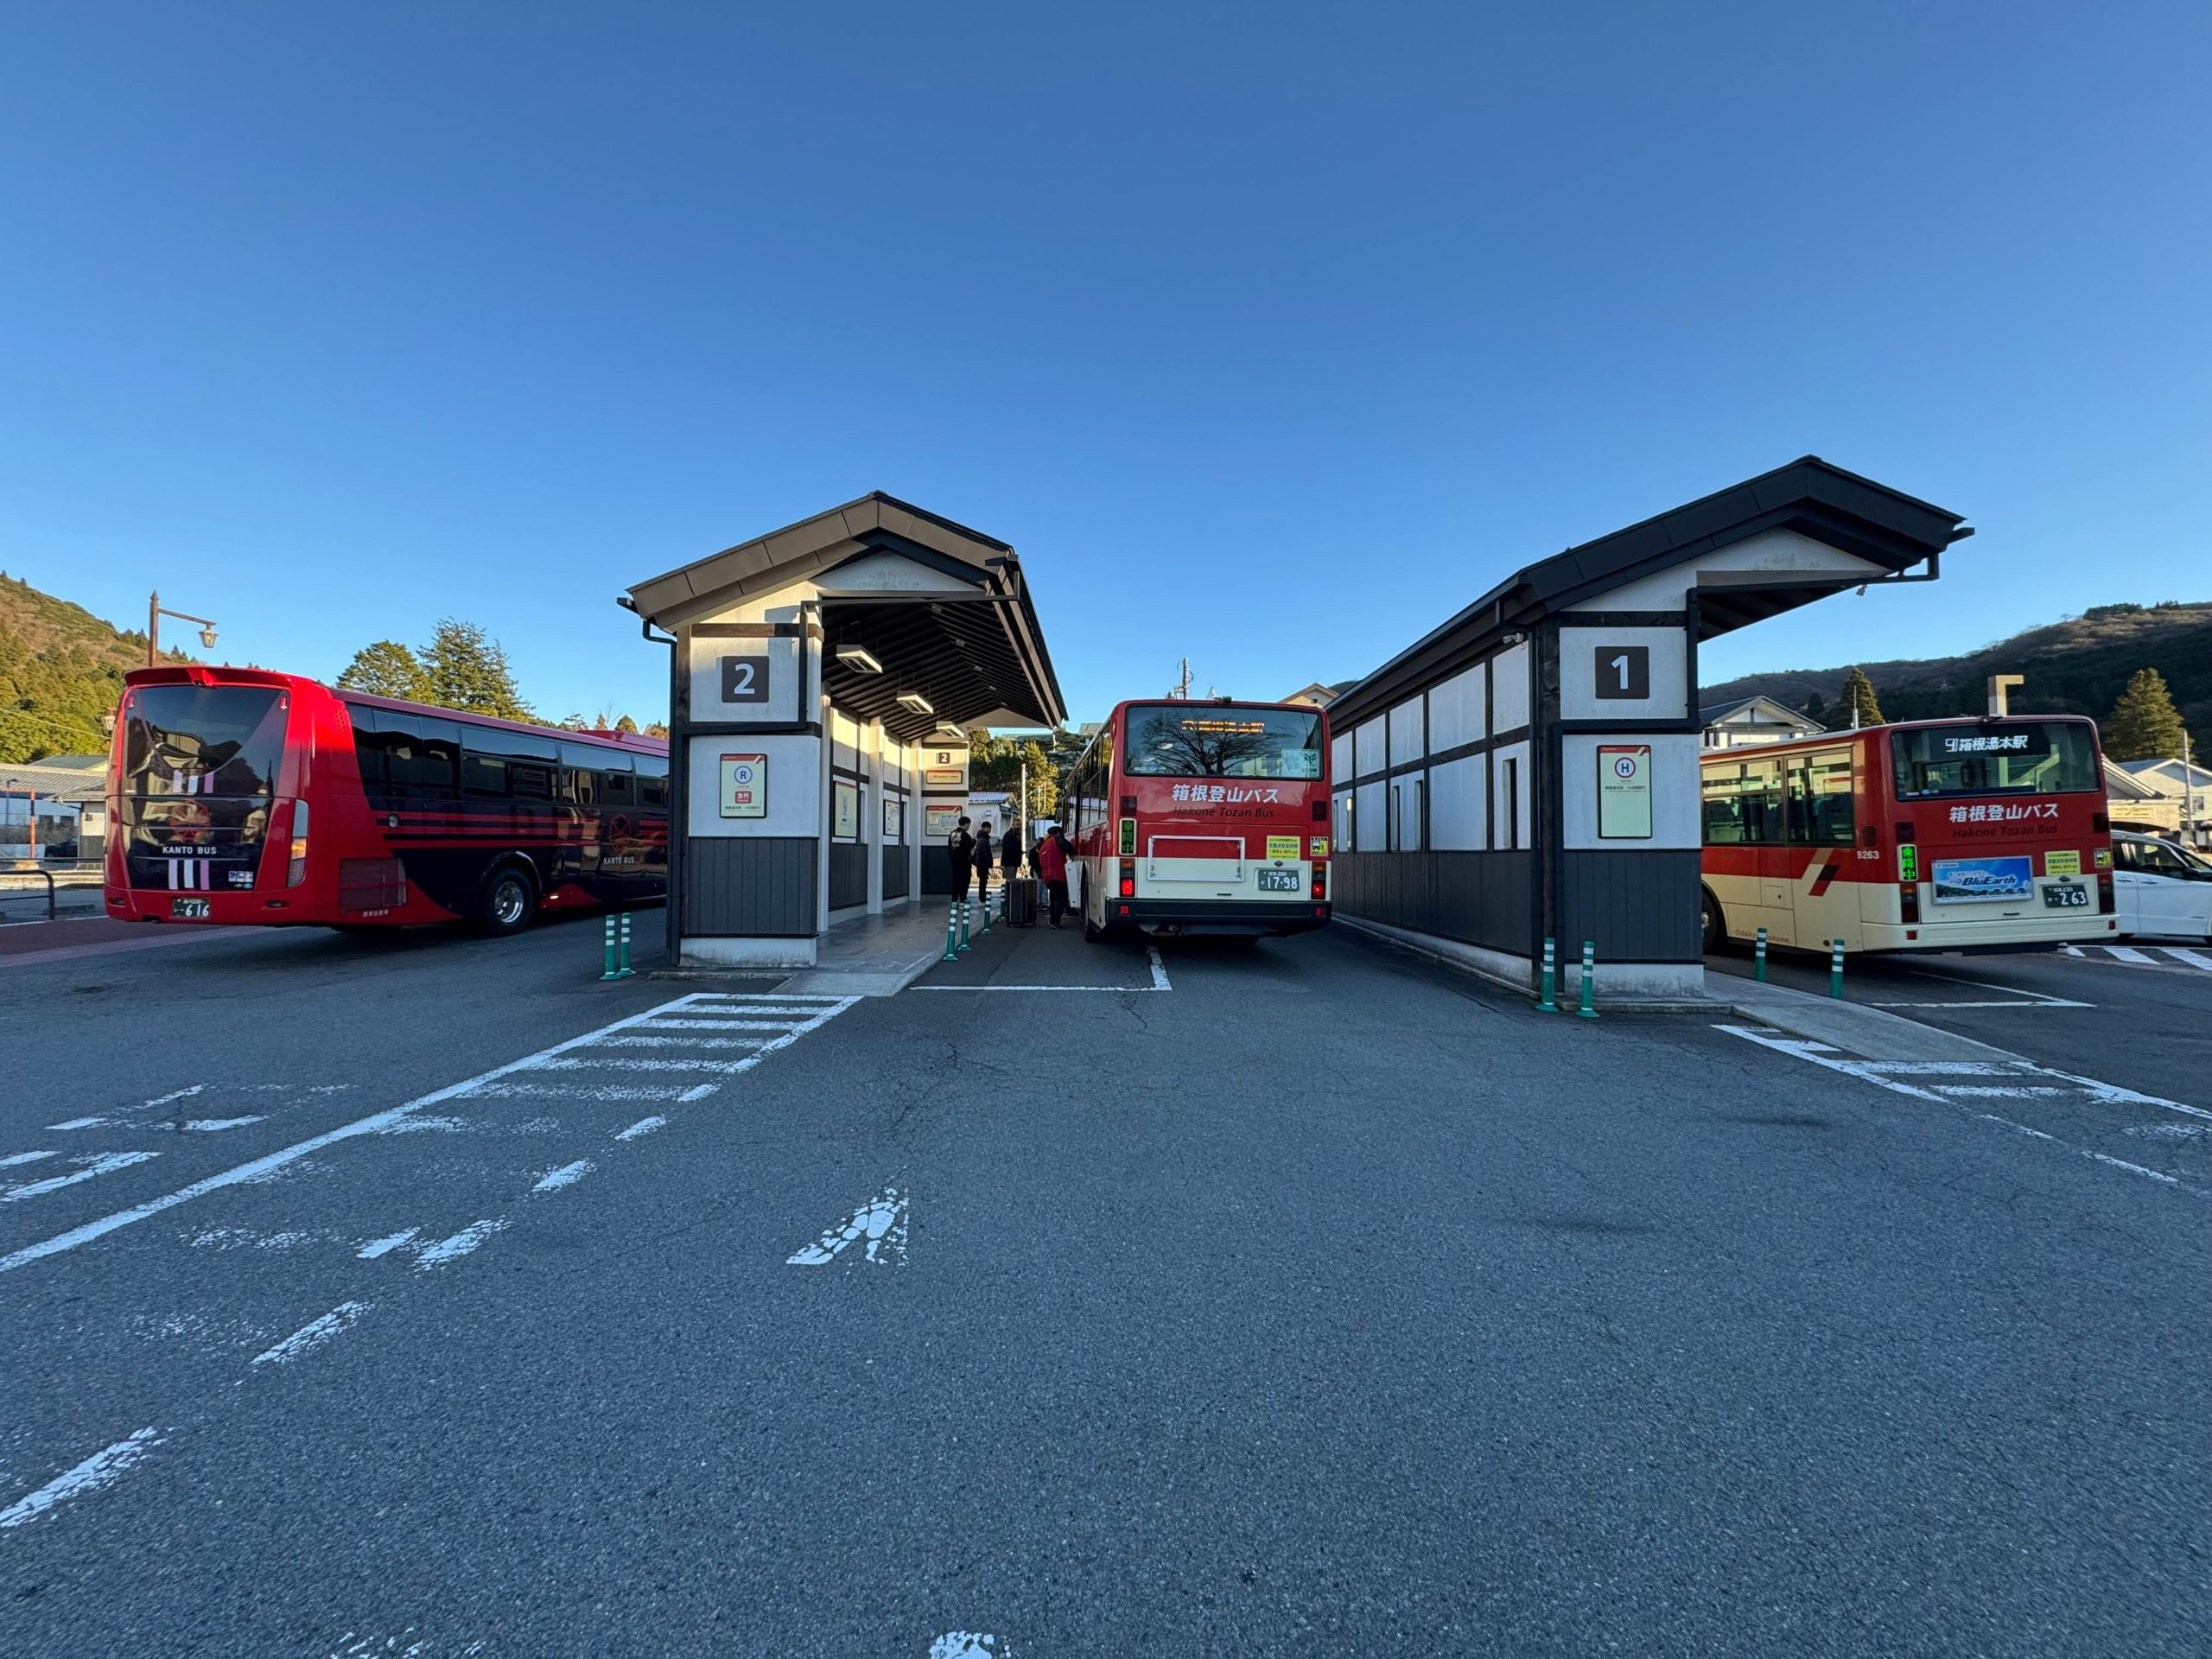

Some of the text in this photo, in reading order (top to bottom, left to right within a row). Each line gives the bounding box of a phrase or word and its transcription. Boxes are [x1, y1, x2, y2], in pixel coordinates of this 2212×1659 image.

[734, 663, 755, 695] 2
[1611, 655, 1629, 690] 1
[941, 753, 948, 762] 2
[1621, 762, 1630, 773] H
[740, 770, 747, 780] R
[1172, 784, 1279, 804] 箱根登山バス
[1173, 806, 1274, 818] Hakone Tozan Bus
[1949, 804, 2059, 823] 箱根登山バス
[2115, 807, 2150, 816] コンビニ
[1952, 823, 2058, 838] Hakone Tozan Bus
[162, 846, 217, 855] KANTO BUS
[1902, 847, 1916, 880] 乗降中
[1267, 876, 1298, 889] 17-98
[1961, 874, 2017, 887] BluEarth
